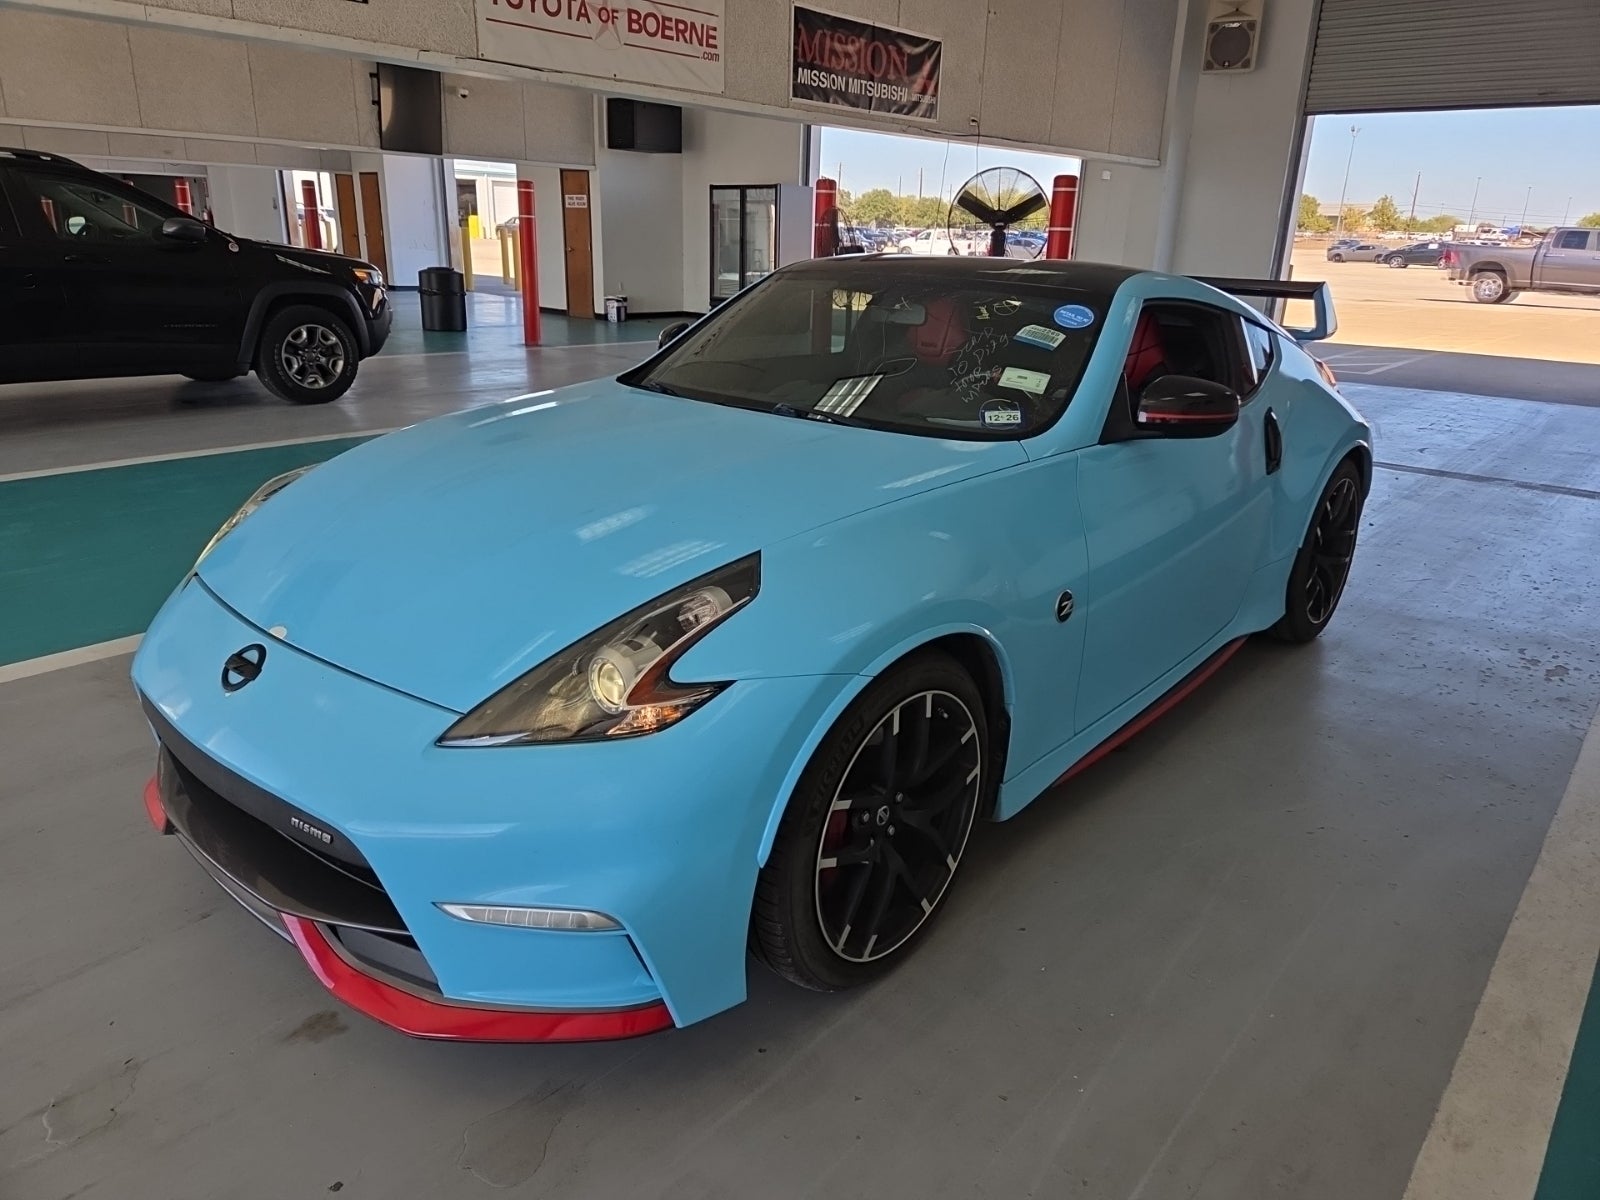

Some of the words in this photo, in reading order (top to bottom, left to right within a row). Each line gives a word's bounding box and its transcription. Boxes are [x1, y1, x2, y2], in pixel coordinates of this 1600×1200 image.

[599, 6, 619, 25] OF
[627, 8, 718, 49] BOERNE
[701, 51, 720, 62] .com
[797, 22, 910, 83] MISSION
[798, 67, 846, 92] MISSION
[848, 77, 908, 102] MITSUBISHI
